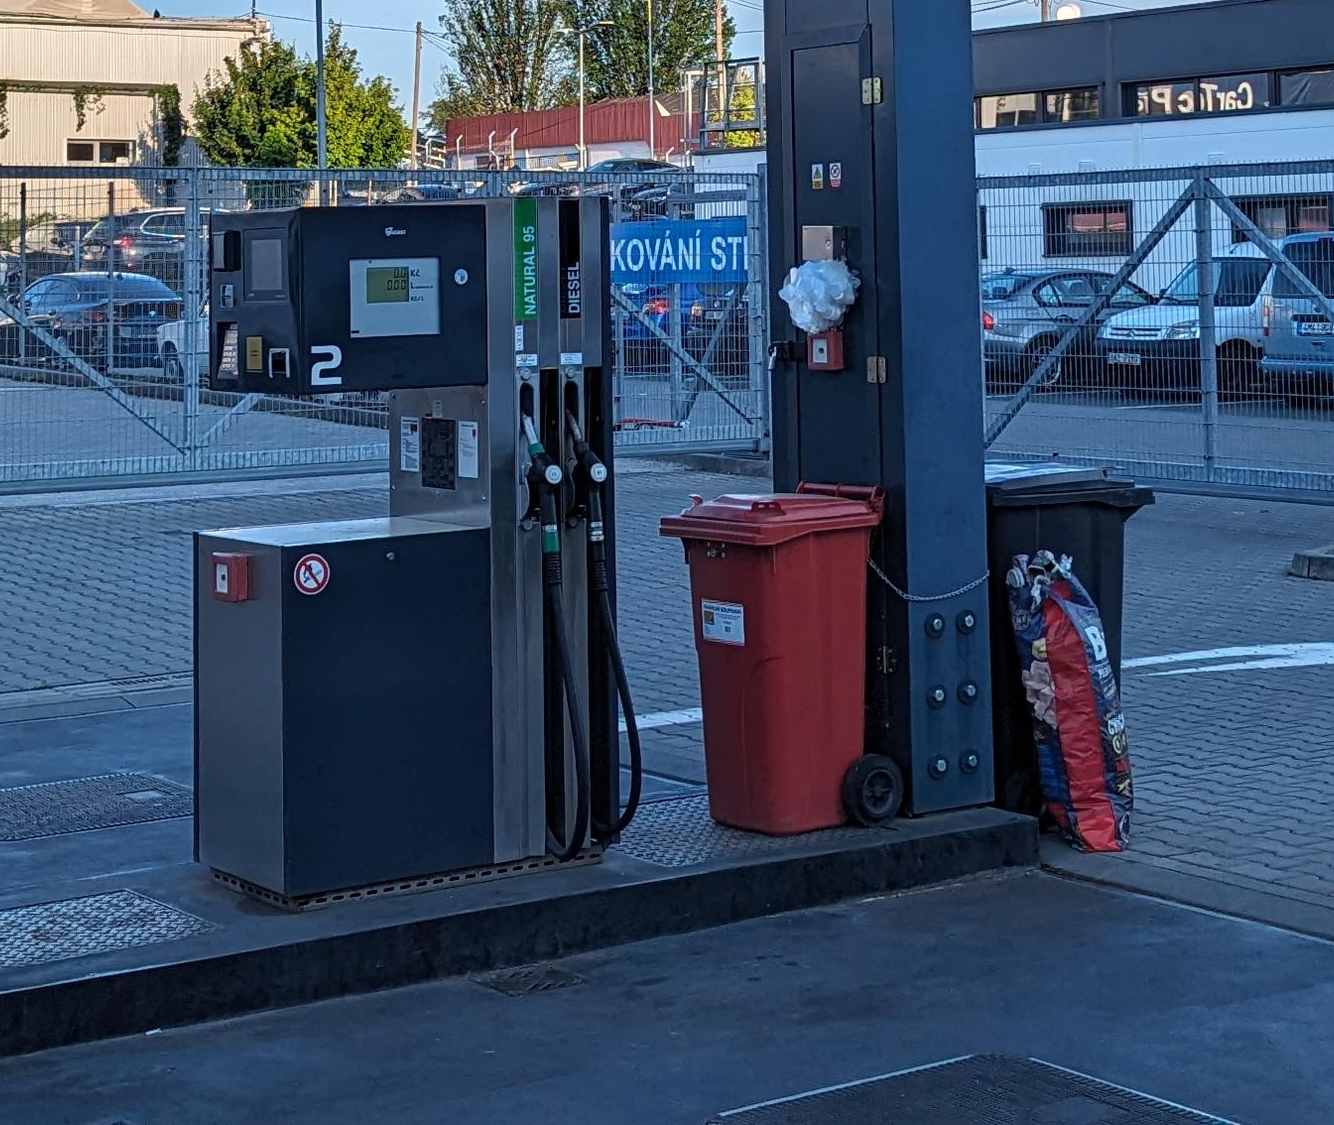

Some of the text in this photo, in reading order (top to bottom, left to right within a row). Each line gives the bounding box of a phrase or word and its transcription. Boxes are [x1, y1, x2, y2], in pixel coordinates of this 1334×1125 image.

[522, 226, 536, 315] NATURAL 95
[567, 262, 580, 313] DIESEL
[310, 345, 342, 386] 2
